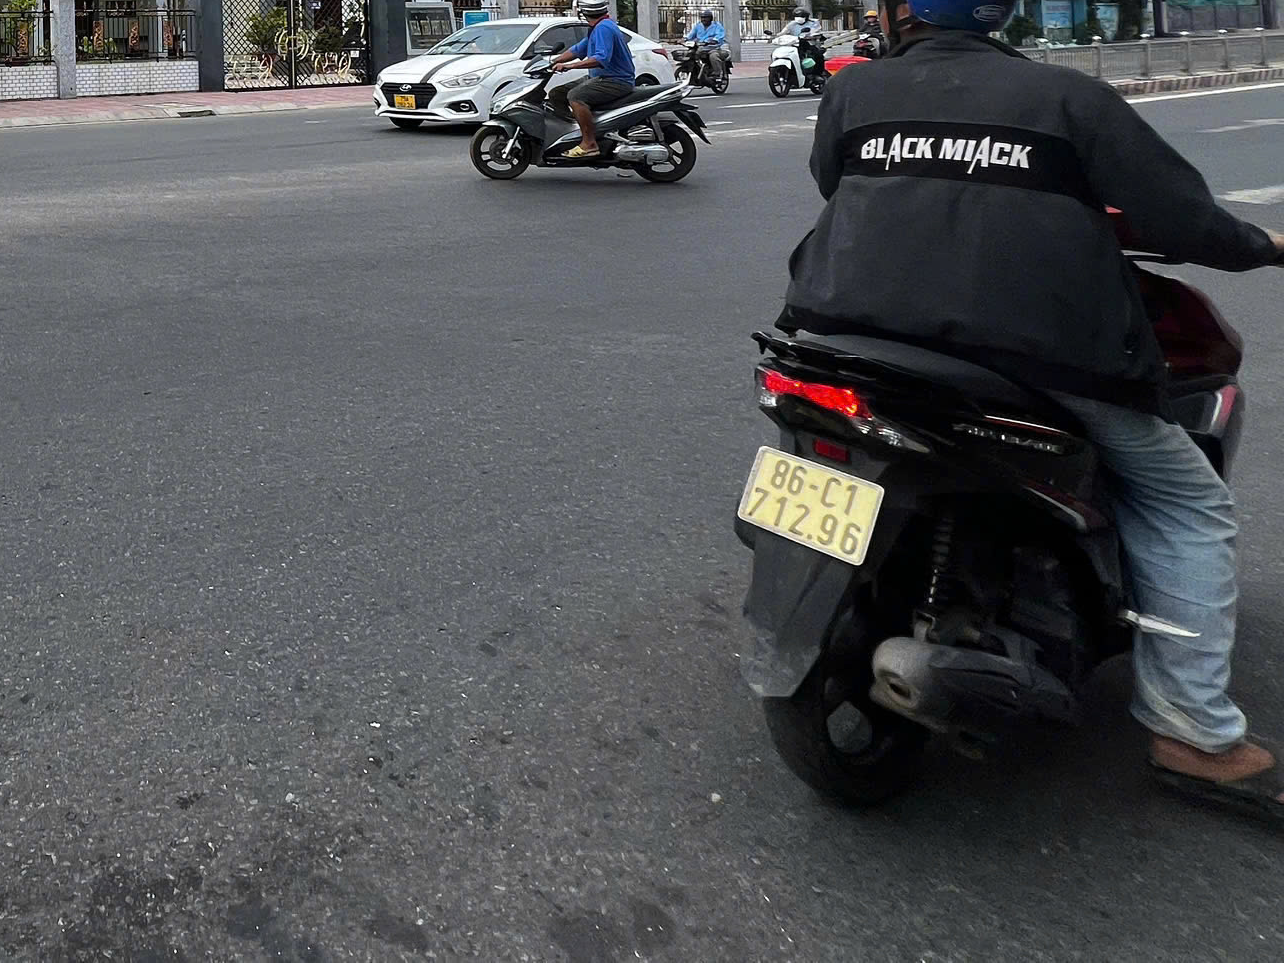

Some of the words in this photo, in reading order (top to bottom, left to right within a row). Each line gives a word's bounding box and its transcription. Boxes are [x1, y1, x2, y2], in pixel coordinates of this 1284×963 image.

[861, 132, 936, 171] BLACK
[938, 135, 1033, 174] MIACK
[770, 459, 859, 516] 86-C1
[748, 487, 862, 555] 712.96
